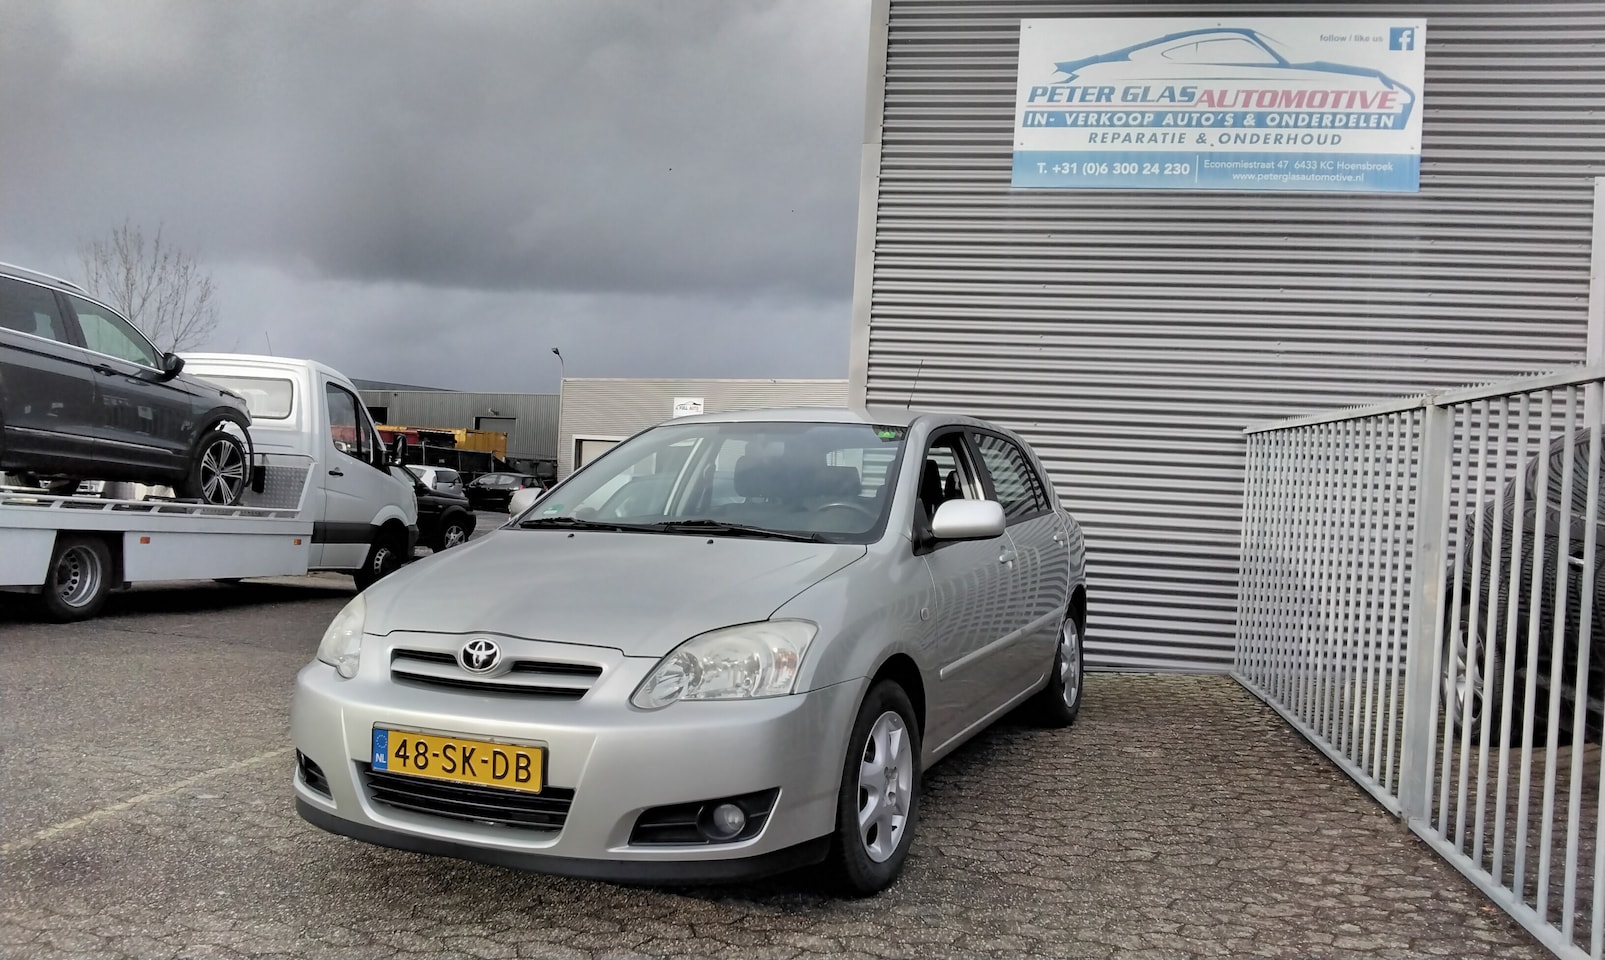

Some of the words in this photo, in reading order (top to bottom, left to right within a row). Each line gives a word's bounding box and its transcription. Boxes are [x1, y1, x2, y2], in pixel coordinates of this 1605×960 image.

[1320, 34, 1347, 42] follow
[1354, 34, 1370, 42] like
[1027, 86, 1116, 103] PETER
[1120, 86, 1198, 103] GLAS
[1196, 88, 1399, 110] AUTOMOTIVE
[1026, 112, 1055, 125] IN-
[1065, 112, 1154, 126] VERKOOP
[1162, 112, 1234, 126] AUTO'S
[1243, 114, 1256, 126] &
[1266, 113, 1395, 128] ONDERDELEN
[1088, 132, 1187, 144] REPARATIE
[1195, 132, 1207, 144] &
[1218, 132, 1342, 146] ONDERHOUD
[1036, 162, 1048, 174] T.
[1052, 162, 1078, 174] +31
[1082, 162, 1108, 176] (0)6
[1112, 162, 1138, 174] 300
[1142, 163, 1160, 175] 24
[1164, 163, 1190, 175] 230
[1204, 160, 1274, 170] Economiestraat
[1277, 160, 1289, 170] 47
[1294, 160, 1317, 170] 6433
[1320, 161, 1334, 170] KC
[1337, 162, 1394, 171] Hoensbroek
[1232, 172, 1364, 184] www.peterglasautomotive.nl
[376, 753, 386, 764] NL
[394, 738, 532, 784] 48-SK-DB
